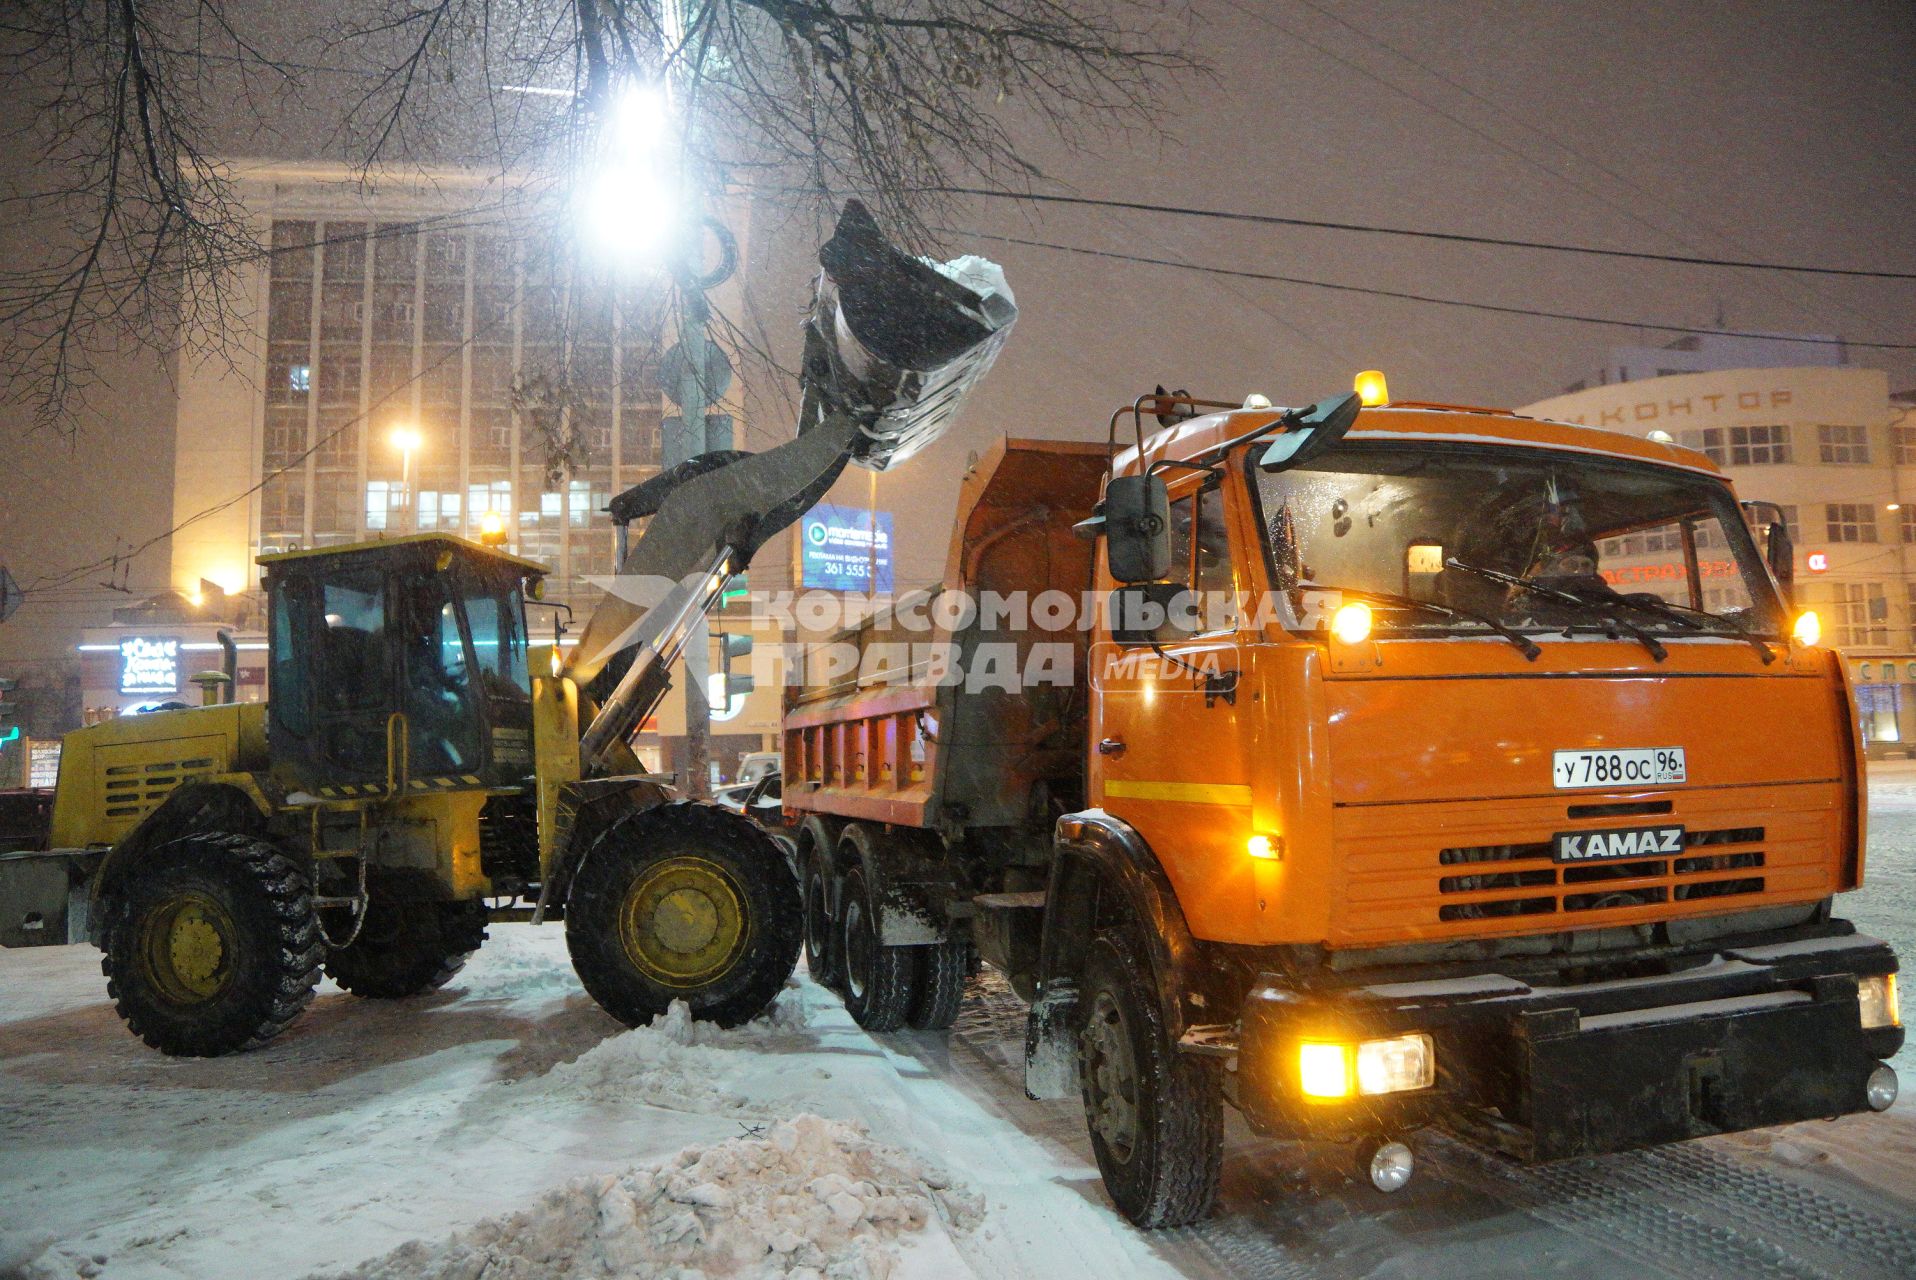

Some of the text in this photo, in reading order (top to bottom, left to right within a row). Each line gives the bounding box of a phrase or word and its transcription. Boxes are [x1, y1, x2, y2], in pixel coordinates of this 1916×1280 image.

[1601, 390, 1792, 425] КОНТОР
[825, 562, 843, 574] 361
[846, 564, 865, 577] 555
[1657, 751, 1677, 771] 96
[1657, 772, 1672, 780] RUS
[1561, 829, 1681, 859] KAMAZ
